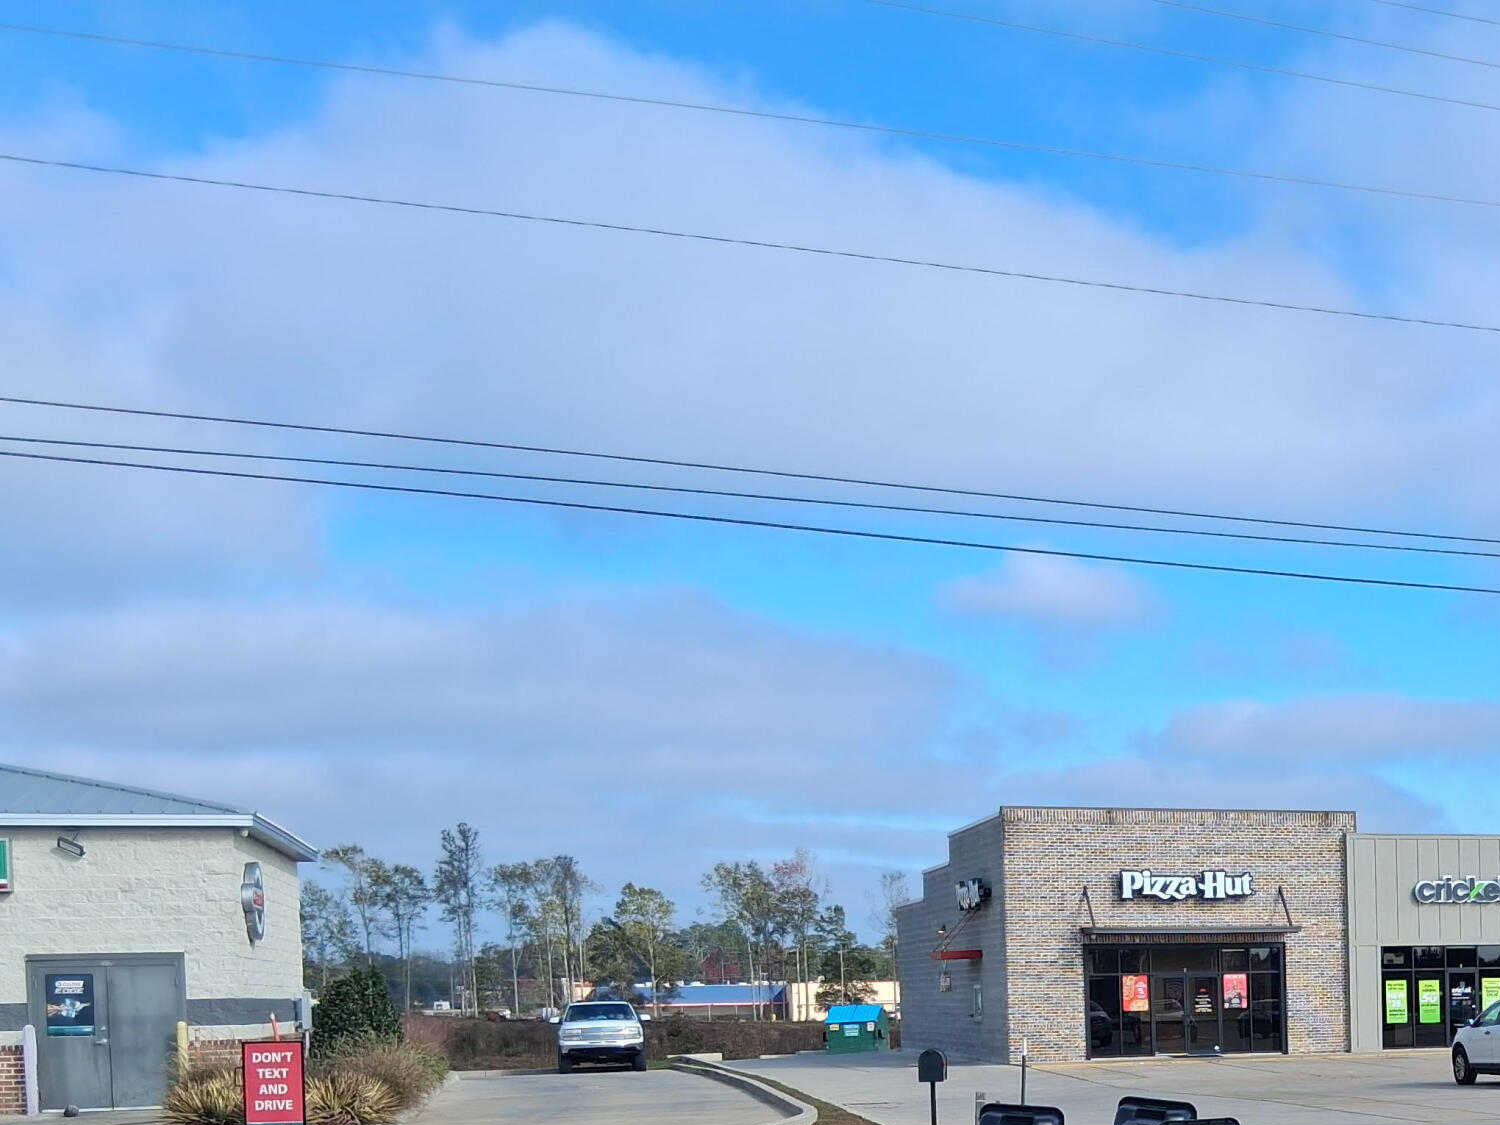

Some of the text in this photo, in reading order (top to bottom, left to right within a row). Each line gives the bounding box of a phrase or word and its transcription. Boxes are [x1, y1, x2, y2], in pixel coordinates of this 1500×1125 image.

[1121, 870, 1253, 900] Pizza Hut
[252, 1052, 293, 1063] DON'T
[257, 1068, 289, 1079] TEXT
[259, 1084, 288, 1095] AND
[255, 1100, 293, 1111] DRIVE
